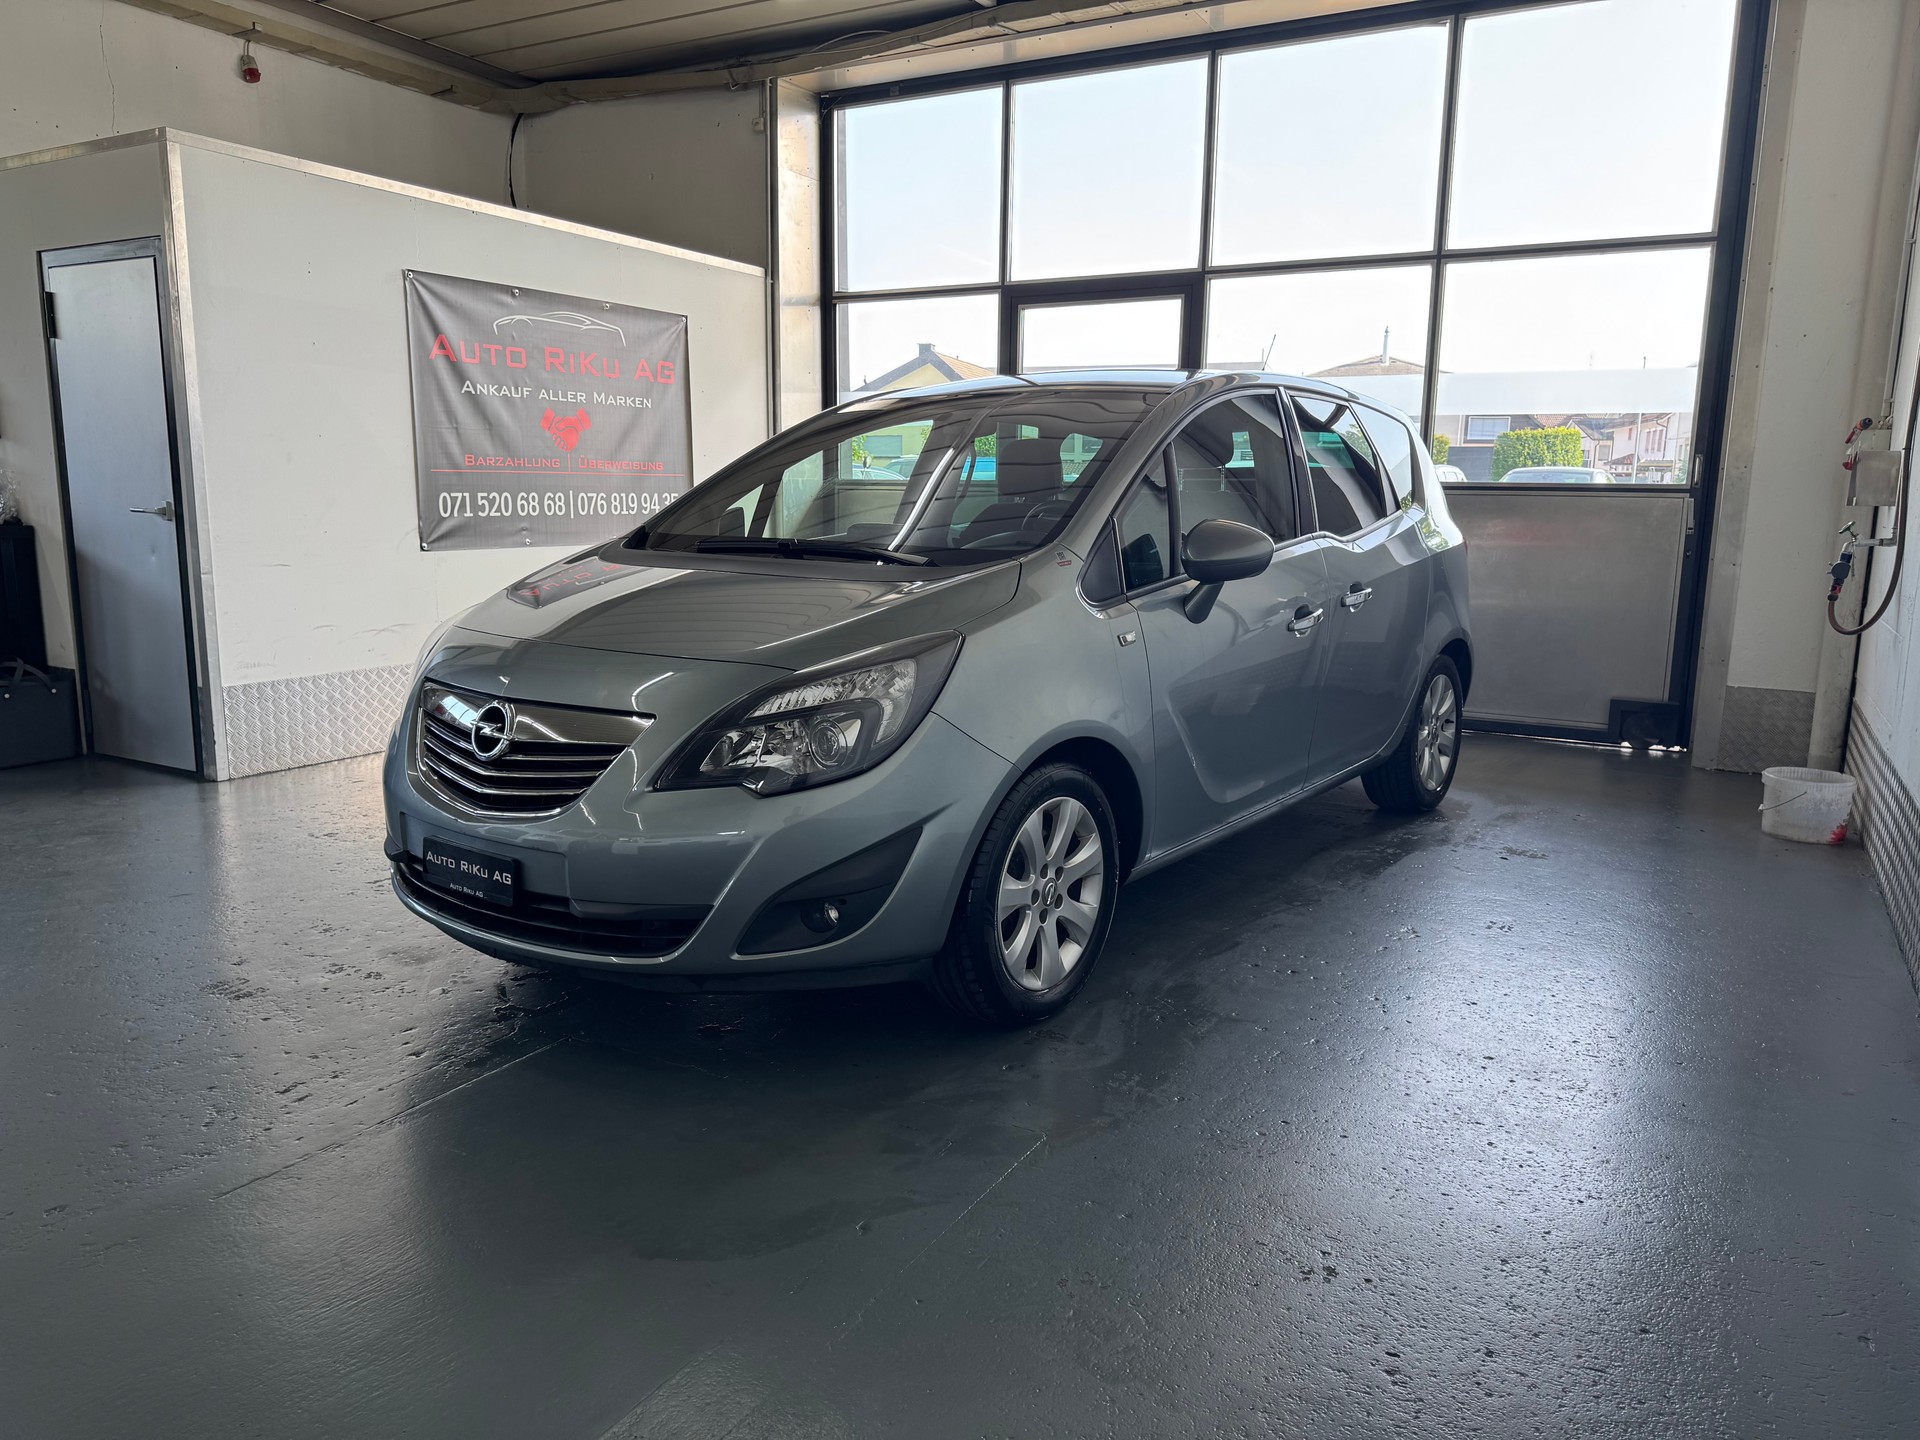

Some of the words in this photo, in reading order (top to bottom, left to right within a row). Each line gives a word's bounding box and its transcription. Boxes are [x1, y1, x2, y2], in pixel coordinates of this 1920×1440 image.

[634, 358, 676, 385] AG
[461, 380, 532, 398] ANKAUF
[538, 388, 587, 404] ALLER
[593, 391, 653, 409] MARKEN
[464, 454, 561, 469] BARZAHLUNG
[438, 491, 473, 518] 071
[477, 491, 513, 518] 520
[517, 491, 540, 517] 68
[543, 491, 566, 517] 68
[577, 491, 606, 516] 076
[611, 492, 637, 516] 819
[641, 492, 661, 515] 94
[493, 870, 512, 885] AG
